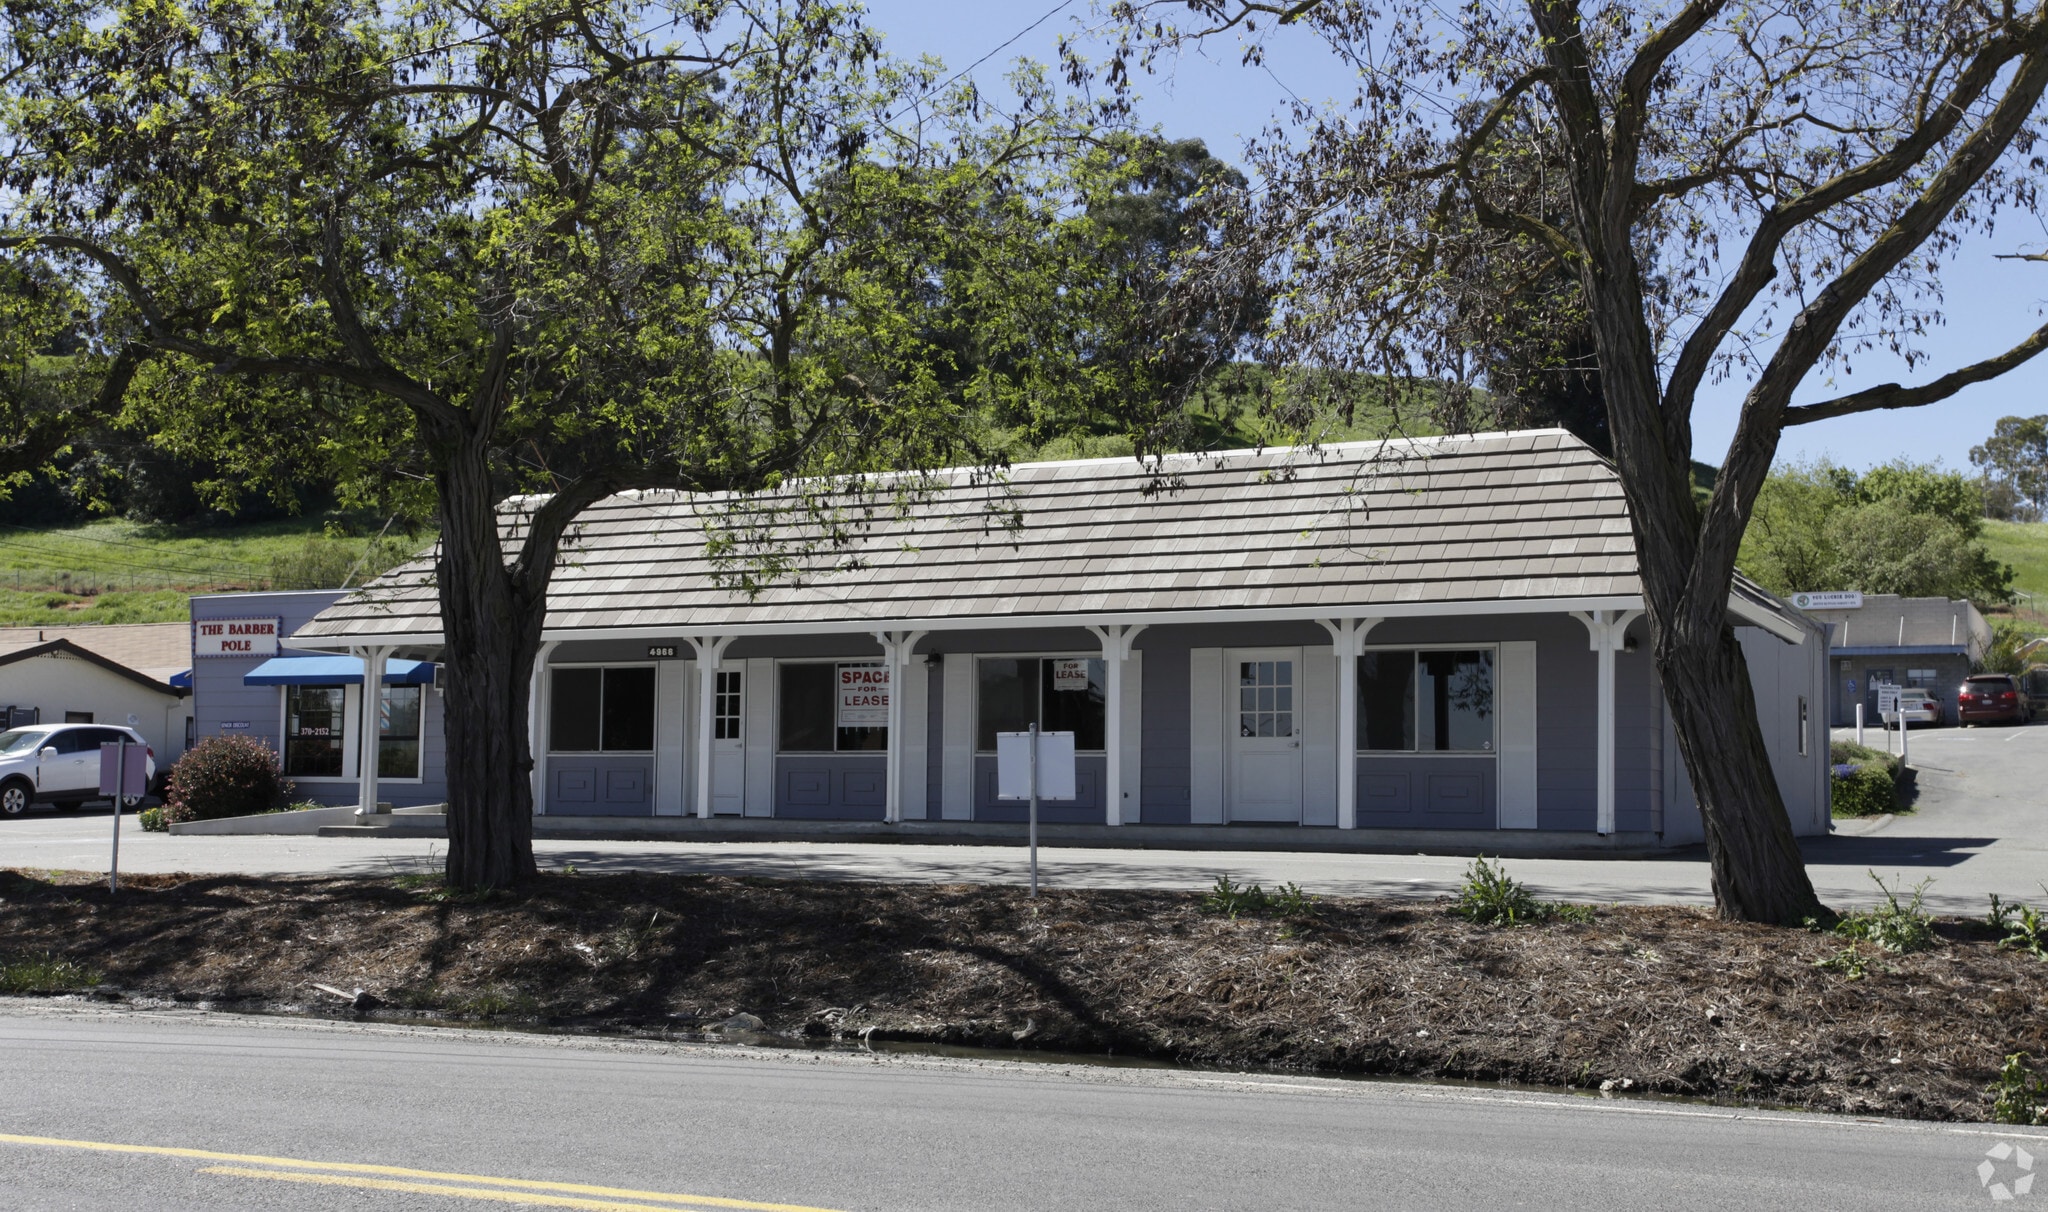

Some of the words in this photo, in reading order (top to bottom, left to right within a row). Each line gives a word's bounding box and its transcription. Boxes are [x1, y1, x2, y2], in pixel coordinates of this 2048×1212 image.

[200, 624, 224, 635] THE
[229, 623, 274, 635] BARBER
[221, 640, 251, 651] POLE
[1056, 671, 1086, 679] LEASE
[844, 695, 889, 706] LEASE
[300, 727, 329, 736] 370-2152
